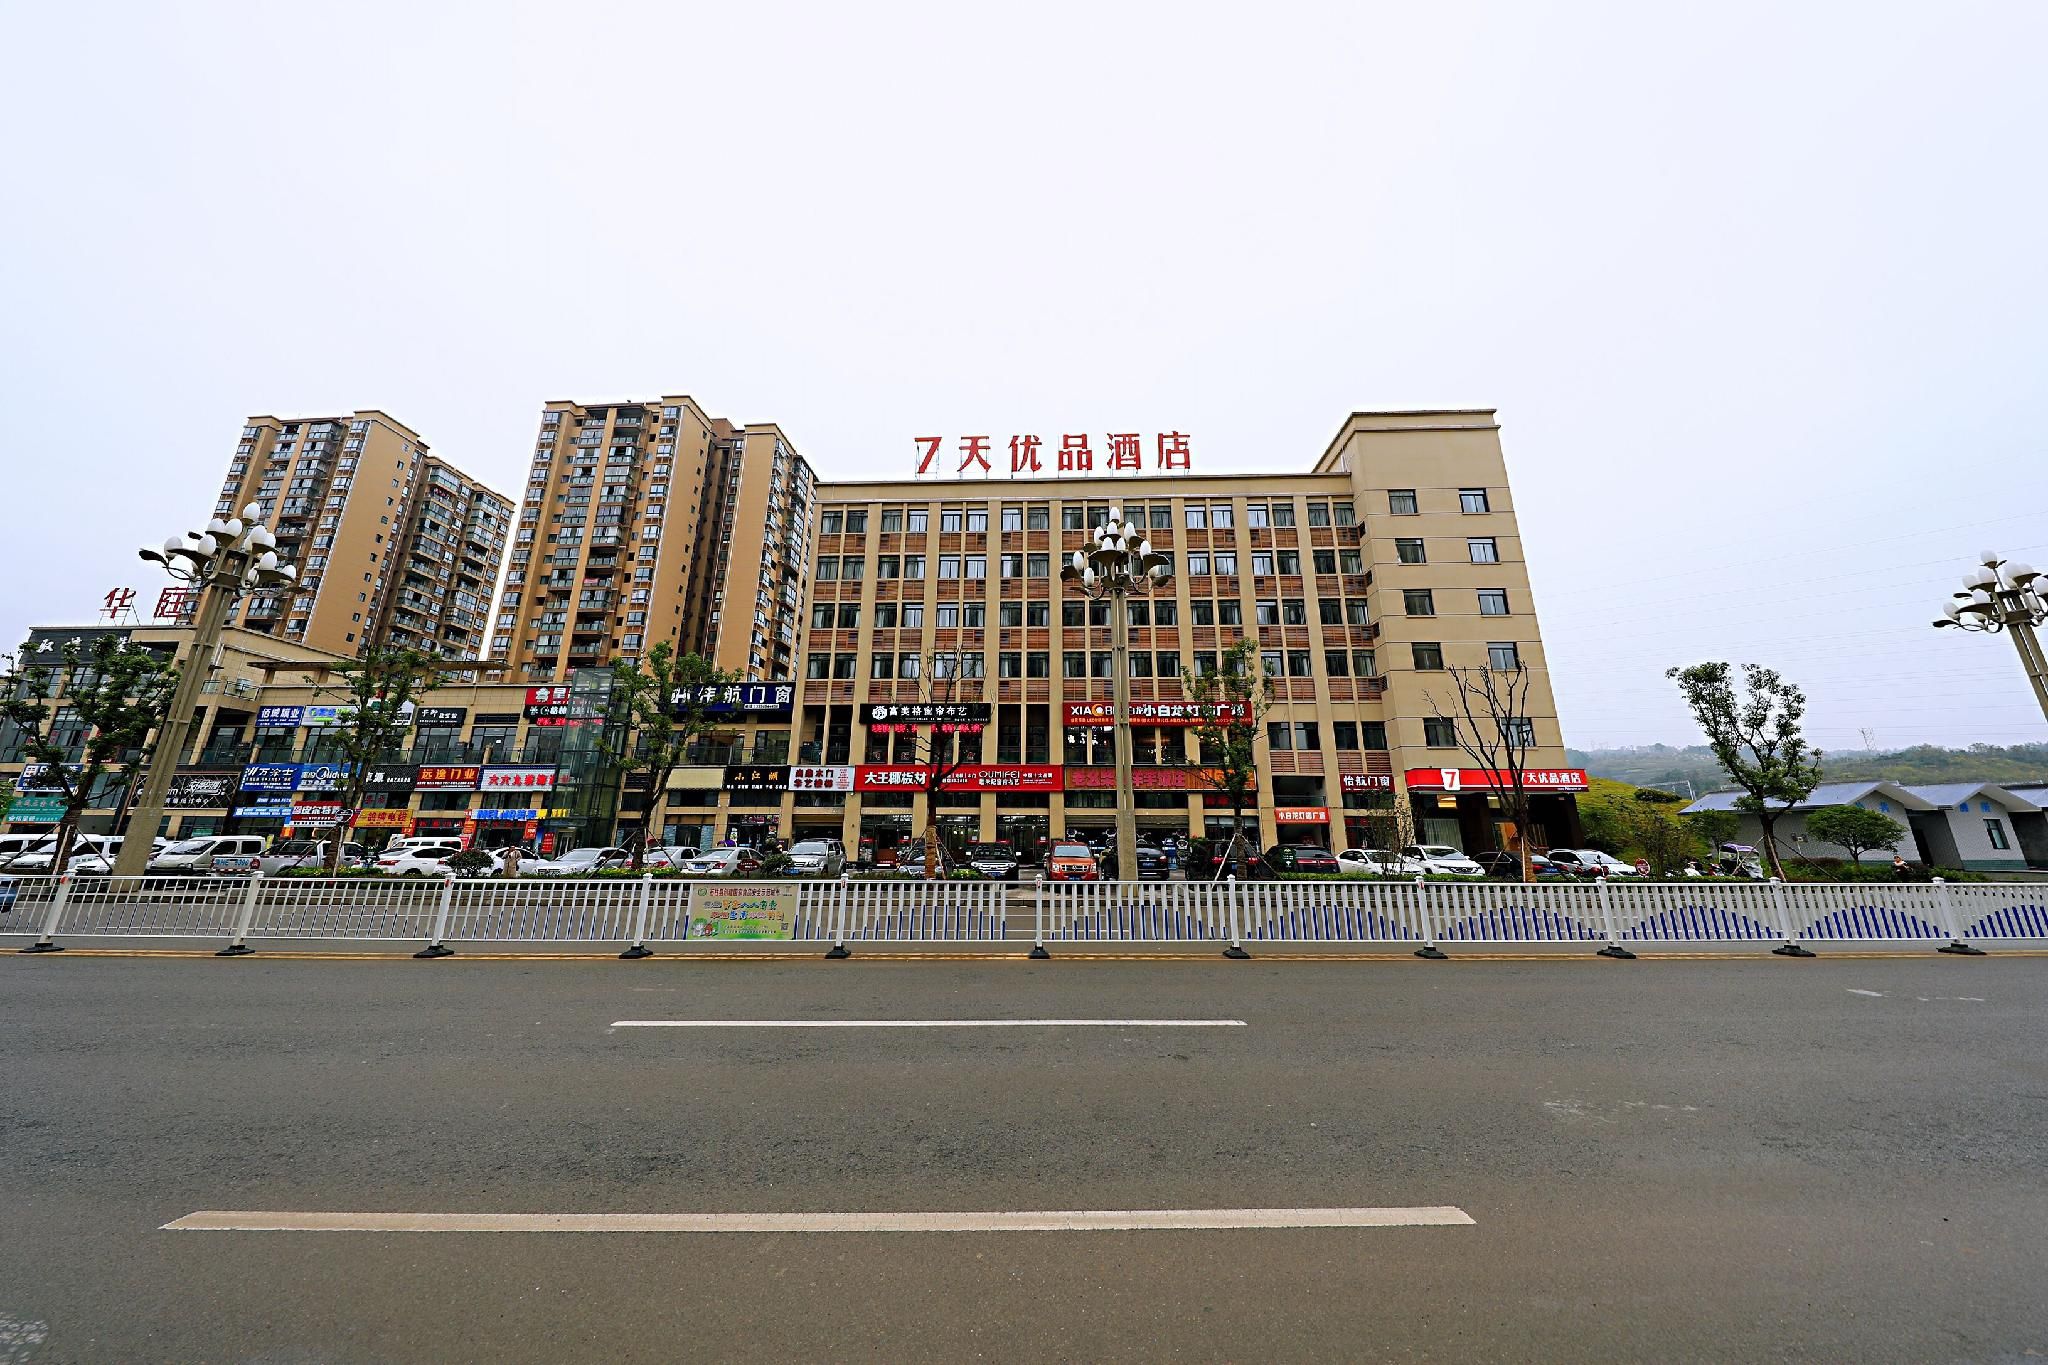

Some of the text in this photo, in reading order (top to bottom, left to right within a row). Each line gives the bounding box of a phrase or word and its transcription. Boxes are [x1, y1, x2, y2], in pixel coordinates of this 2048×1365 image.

[914, 431, 1191, 473] 7天优品酒店
[864, 771, 927, 785] 大王椰板材
[1444, 772, 1457, 788] 7
